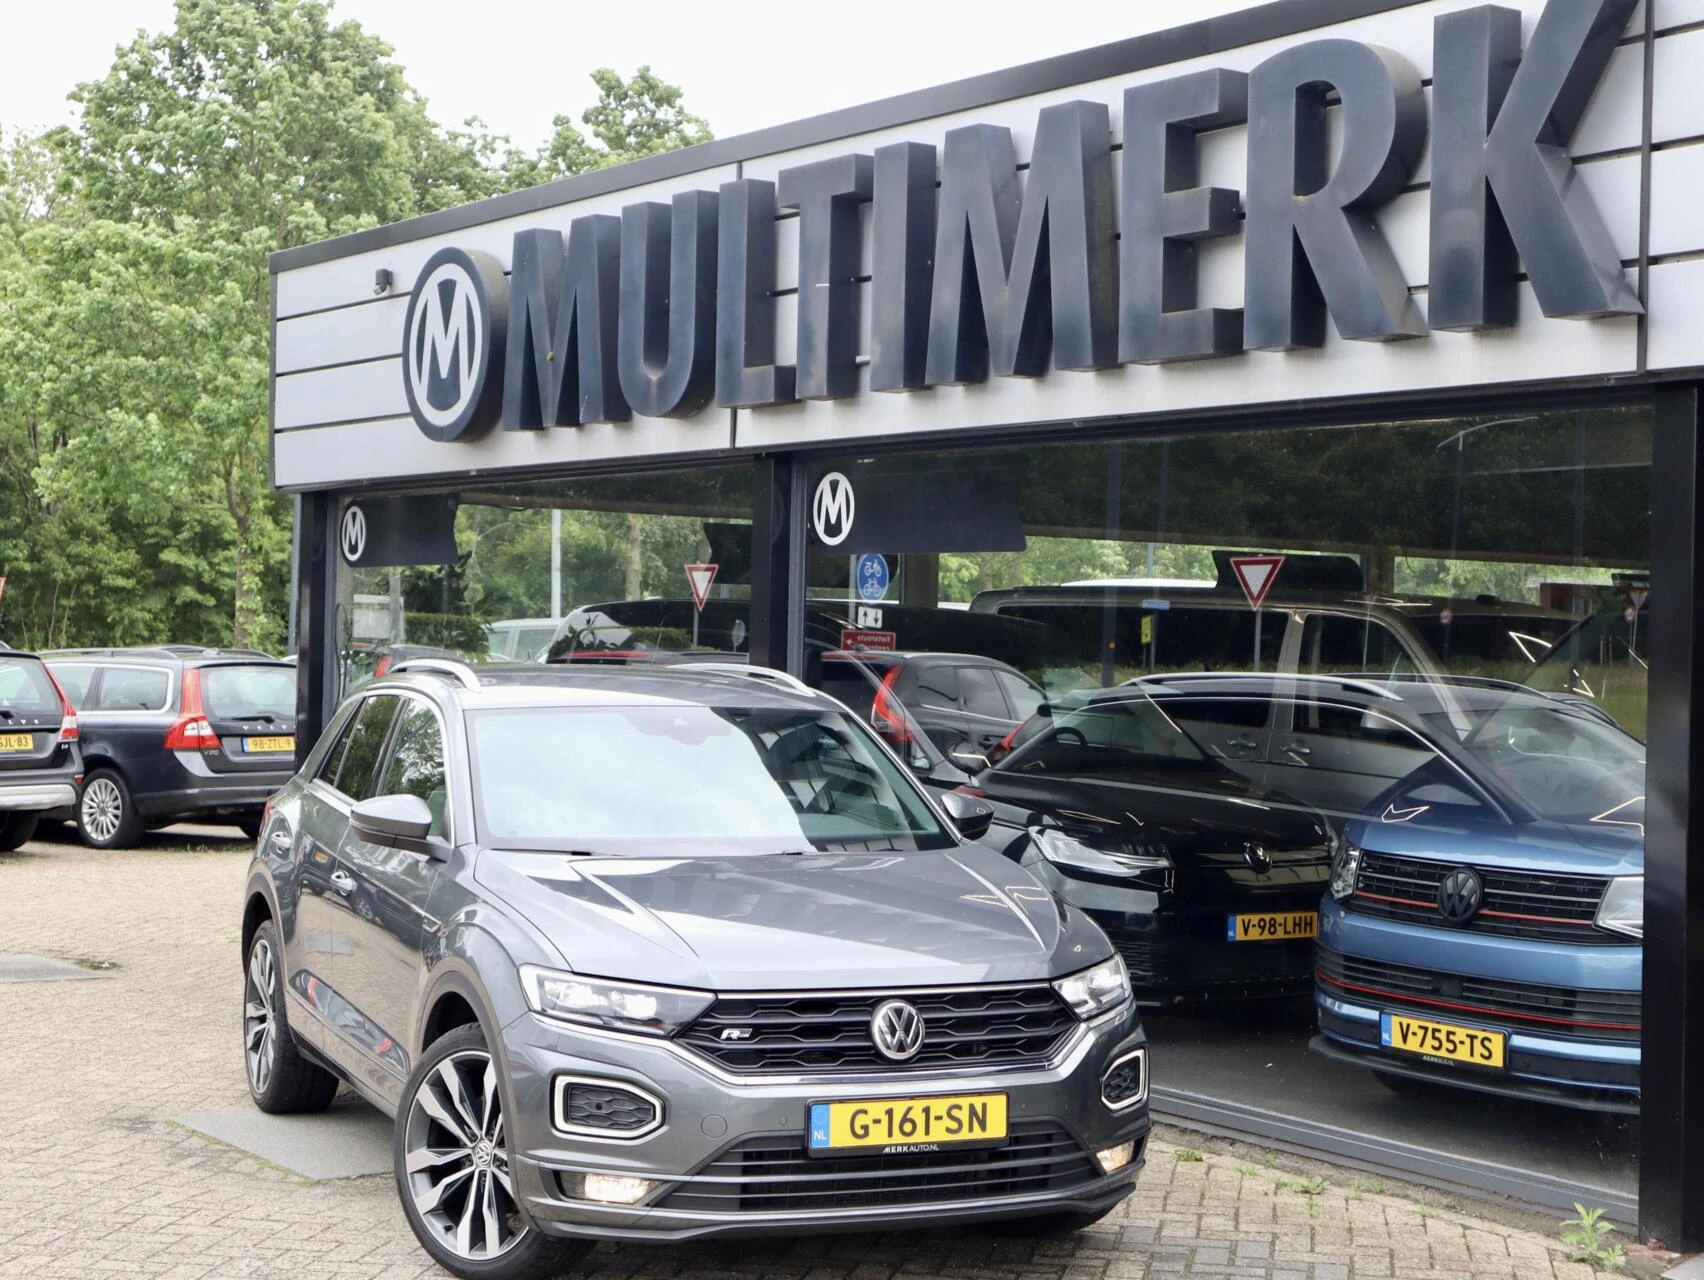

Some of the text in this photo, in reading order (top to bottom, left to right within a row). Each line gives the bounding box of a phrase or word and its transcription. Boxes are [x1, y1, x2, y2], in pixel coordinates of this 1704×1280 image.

[502, 0, 1645, 431] MULTIMERK
[409, 262, 483, 427] M
[813, 472, 855, 546] M
[1241, 915, 1314, 937] V-98-LHH
[1399, 1021, 1493, 1061] V-755-TS
[814, 1131, 828, 1141] NL
[850, 1102, 988, 1140] G-161-SN
